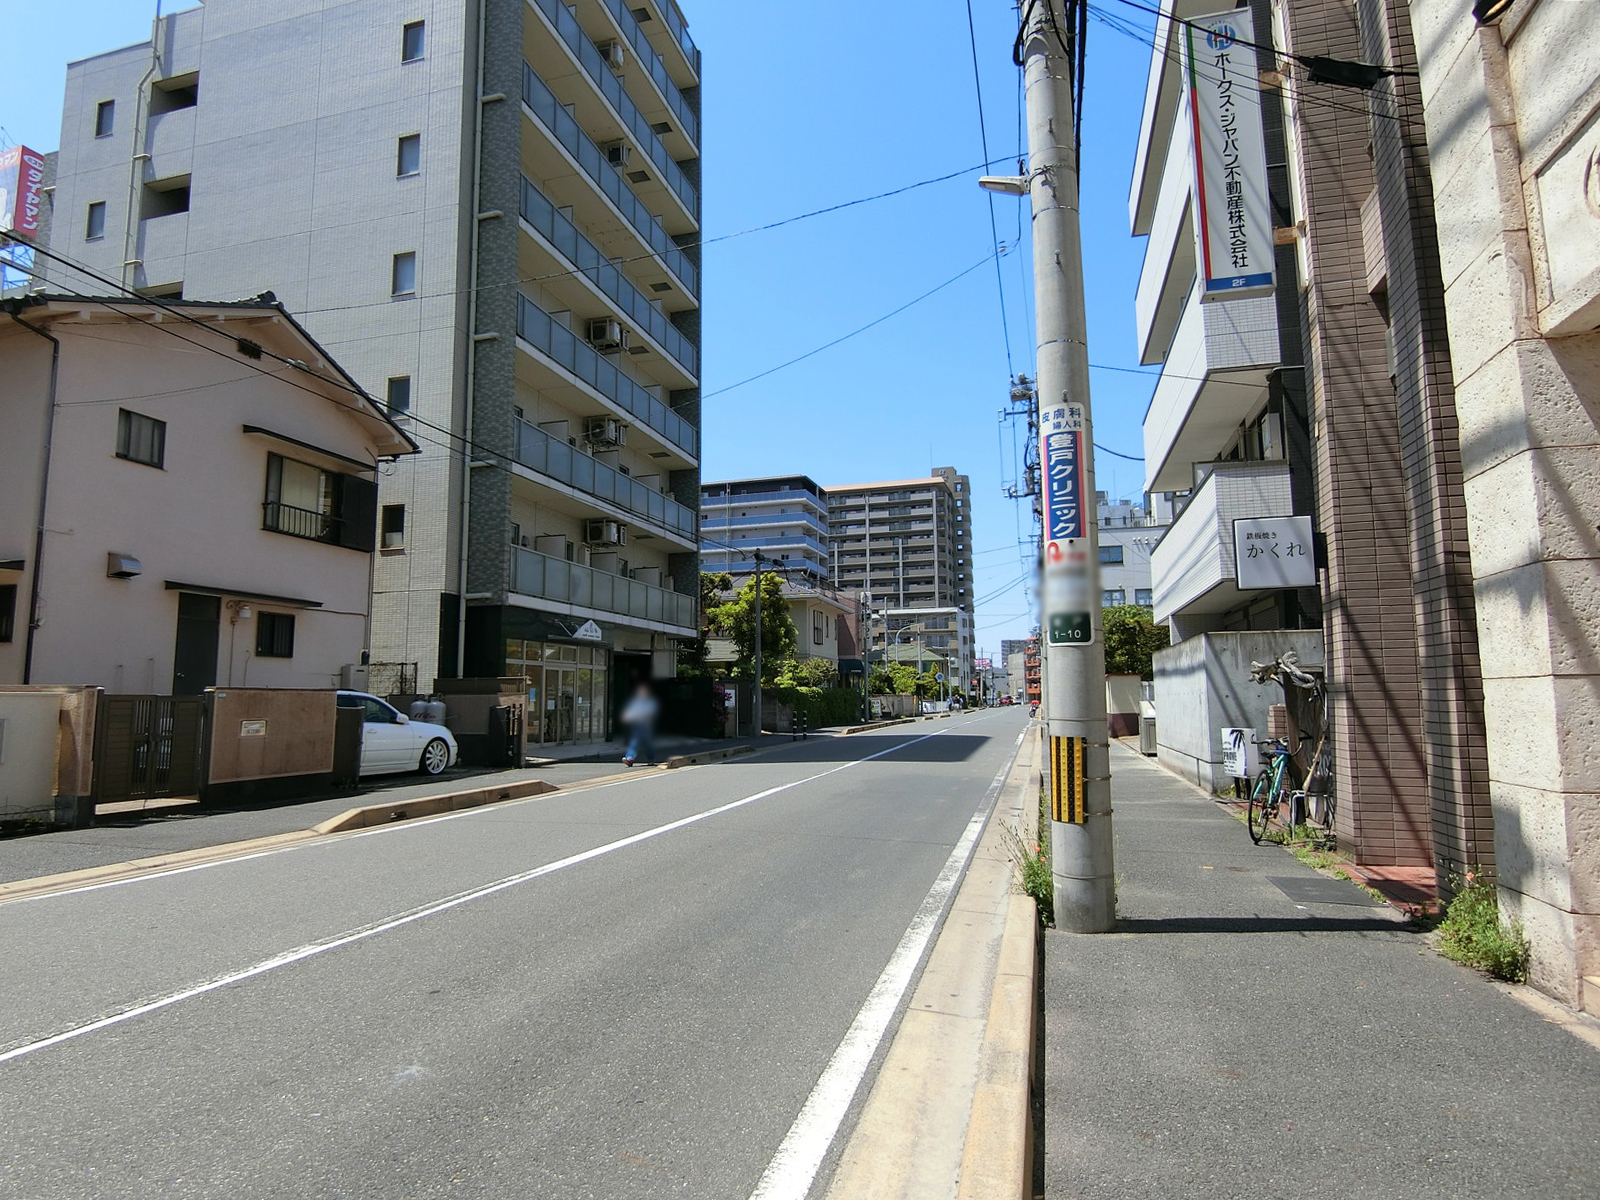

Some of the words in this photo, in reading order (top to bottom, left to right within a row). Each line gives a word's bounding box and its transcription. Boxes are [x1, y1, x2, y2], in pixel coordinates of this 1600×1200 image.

[1214, 52, 1249, 269] ホークス・ジャパン不動産株式会社
[1232, 278, 1246, 287] 2F
[1042, 407, 1081, 423] 皮膚科
[1048, 433, 1076, 537] 登戸クリニック
[1246, 532, 1277, 540] 鉄板焼き
[1246, 541, 1306, 559] かくれ
[1054, 629, 1081, 639] 1-10
